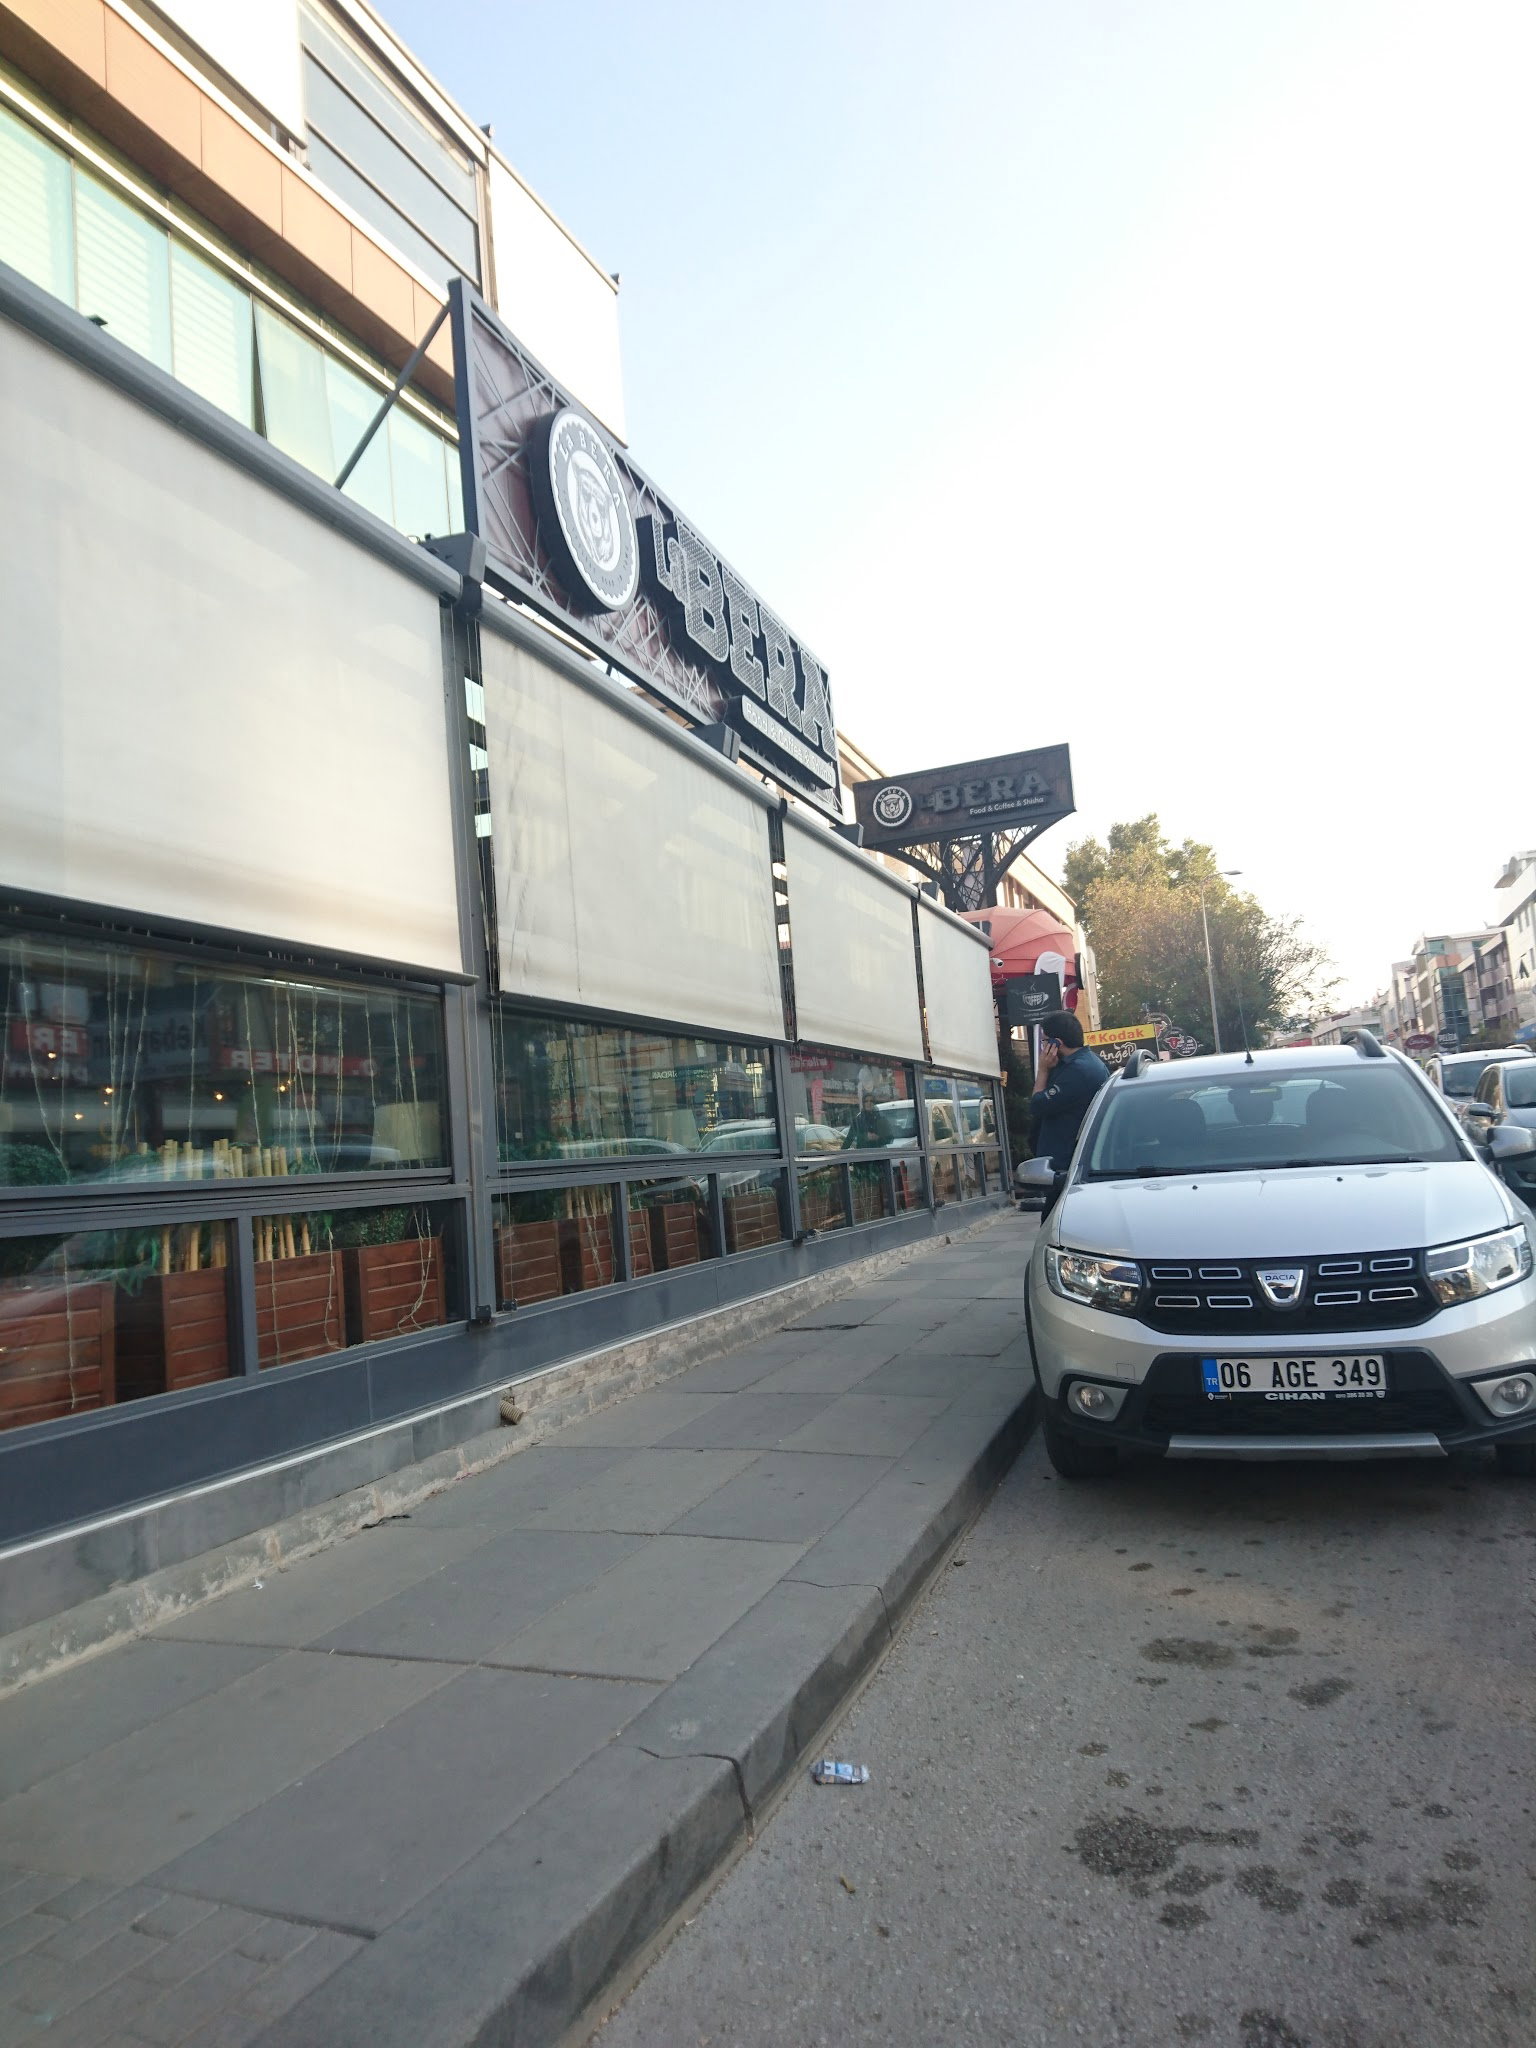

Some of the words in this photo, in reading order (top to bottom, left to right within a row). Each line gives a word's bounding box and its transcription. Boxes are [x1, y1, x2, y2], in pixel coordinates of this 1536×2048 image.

[677, 519, 838, 761] BERA
[746, 702, 769, 735] Food
[933, 770, 1050, 813] BERA
[969, 806, 986, 815] Food
[994, 801, 1015, 810] Coffee
[1022, 796, 1044, 806] Shisha
[1098, 1028, 1145, 1043] Kodak
[1206, 1377, 1219, 1386] TR
[1220, 1362, 1252, 1389] 06
[1271, 1360, 1319, 1388] AGE
[1331, 1358, 1381, 1387] 349
